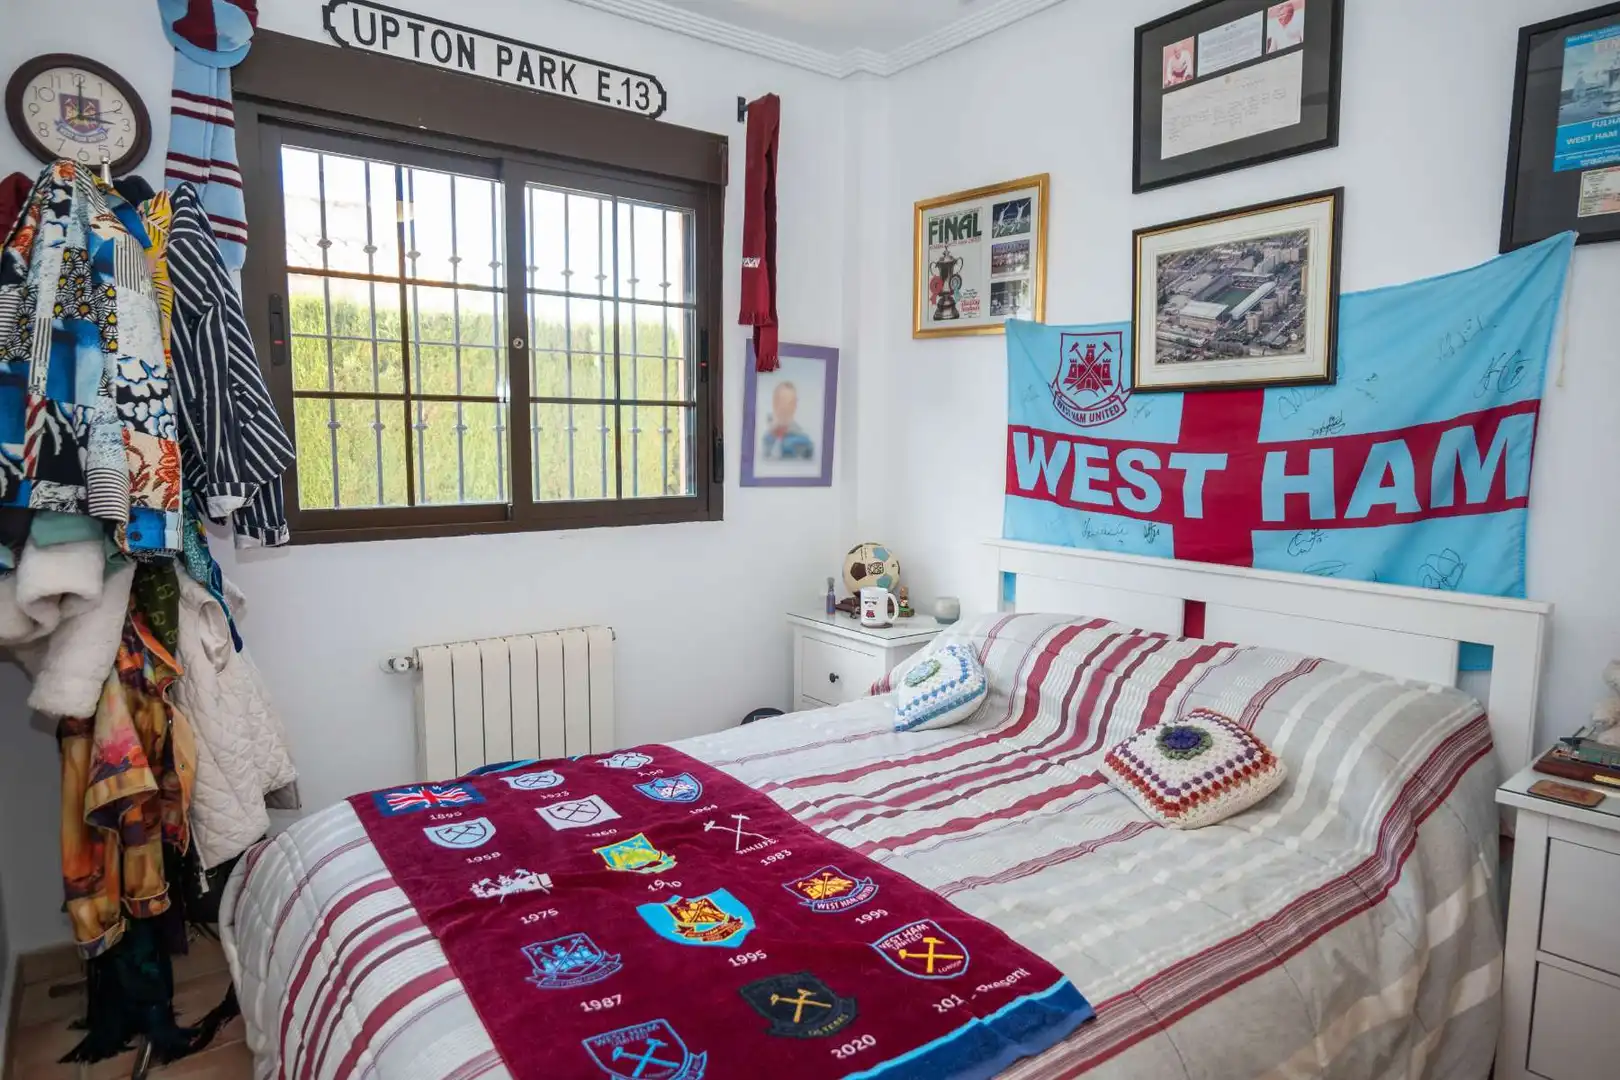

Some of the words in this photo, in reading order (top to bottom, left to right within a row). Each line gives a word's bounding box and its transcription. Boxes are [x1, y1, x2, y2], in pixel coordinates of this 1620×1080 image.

[352, 7, 476, 71] UPTON
[497, 44, 578, 95] PARK
[598, 69, 650, 110] E.13
[32, 86, 55, 102] 10
[28, 102, 40, 117] 9
[38, 121, 49, 137] 8
[121, 118, 131, 132] 3
[1566, 134, 1593, 145] WEST
[1595, 130, 1618, 141] HAM
[929, 212, 982, 246] FINAL
[1089, 404, 1120, 422] UNITED
[1013, 431, 1228, 520] WEST
[1261, 412, 1537, 522] HAM
[760, 849, 792, 866] 1983
[816, 902, 840, 910] WEST
[520, 907, 559, 925] 1975
[855, 908, 889, 924] 1999
[903, 923, 930, 938] HAM
[728, 949, 767, 967] 1995
[580, 994, 622, 1012] 1987
[831, 1034, 877, 1059] 2020
